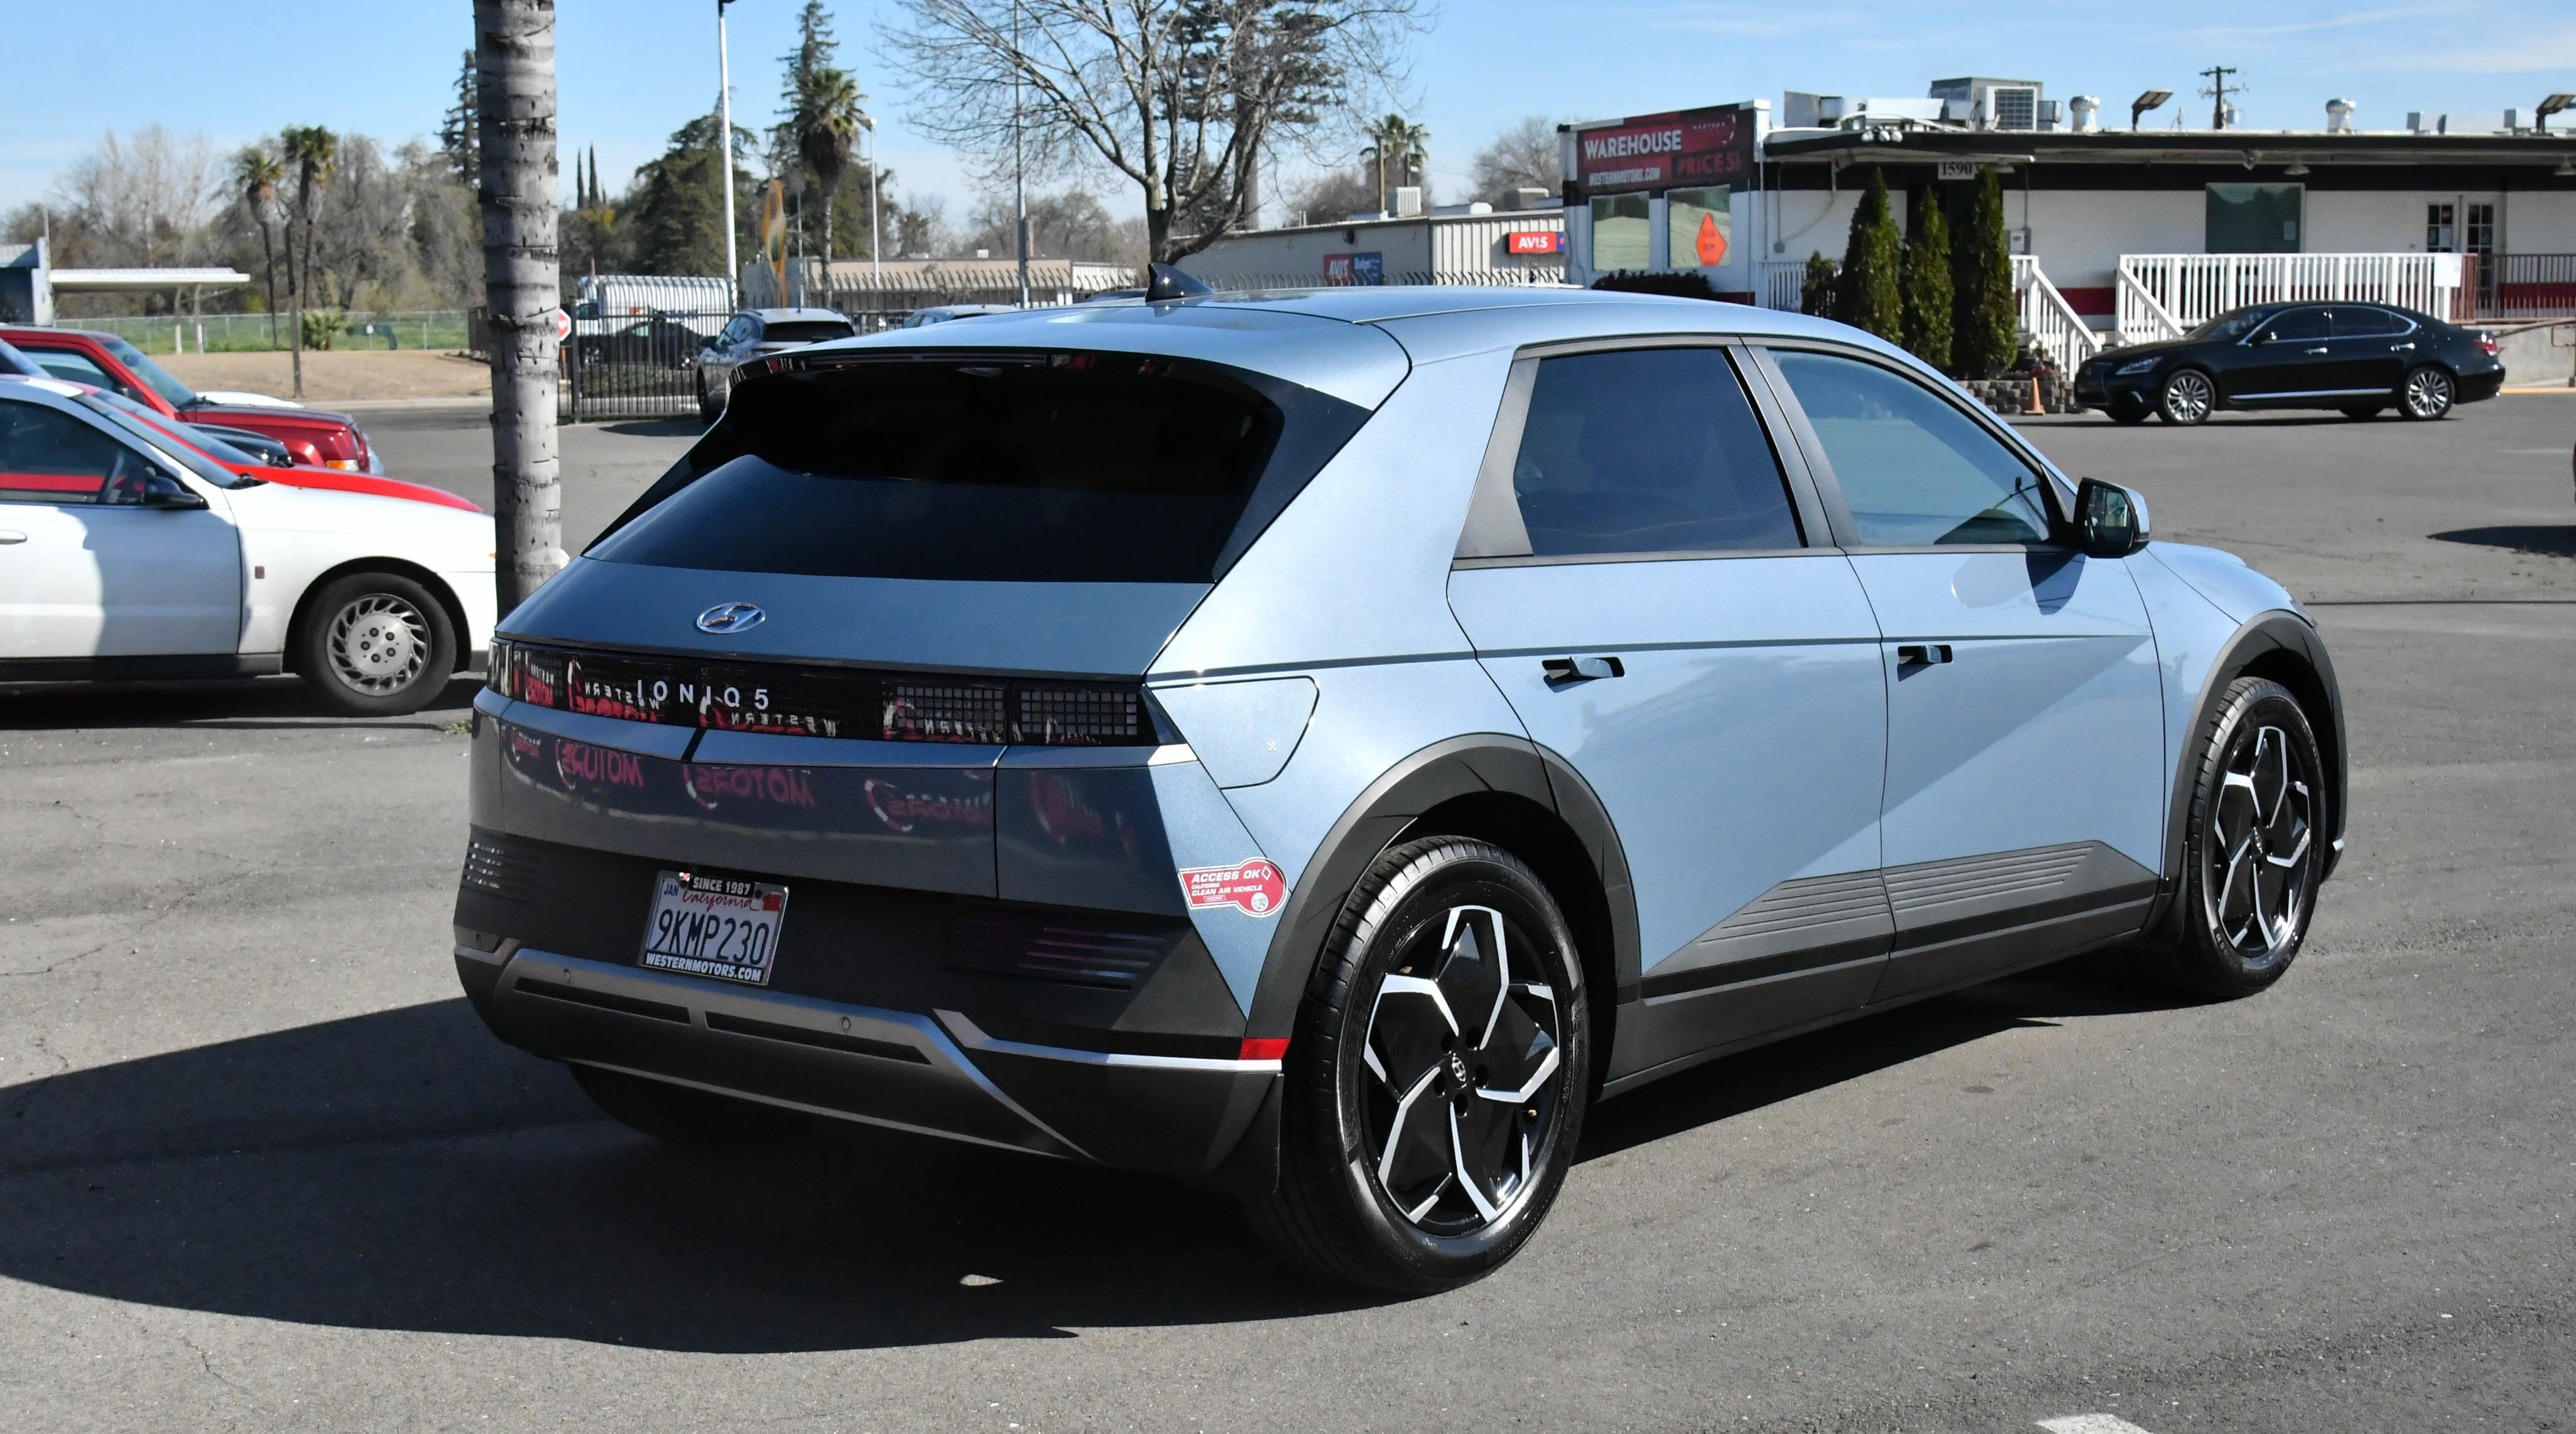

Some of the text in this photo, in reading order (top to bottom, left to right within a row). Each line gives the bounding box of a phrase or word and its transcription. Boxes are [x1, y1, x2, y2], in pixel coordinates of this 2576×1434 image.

[1584, 129, 1682, 160] WAREHOUSE
[1942, 161, 1972, 175] 1590
[1518, 236, 1548, 249] AVIS
[638, 680, 769, 710] IONIQ 5
[1191, 869, 1261, 883] ACCESS OK
[663, 883, 679, 897] JAN
[693, 877, 751, 895] SINCE 1987
[1192, 888, 1216, 896] CLEAN
[1233, 884, 1263, 893] VEHICLE
[682, 891, 760, 912] California
[653, 909, 769, 965] 9KMP230
[646, 953, 762, 982] WESTERNMOTORS.COM
